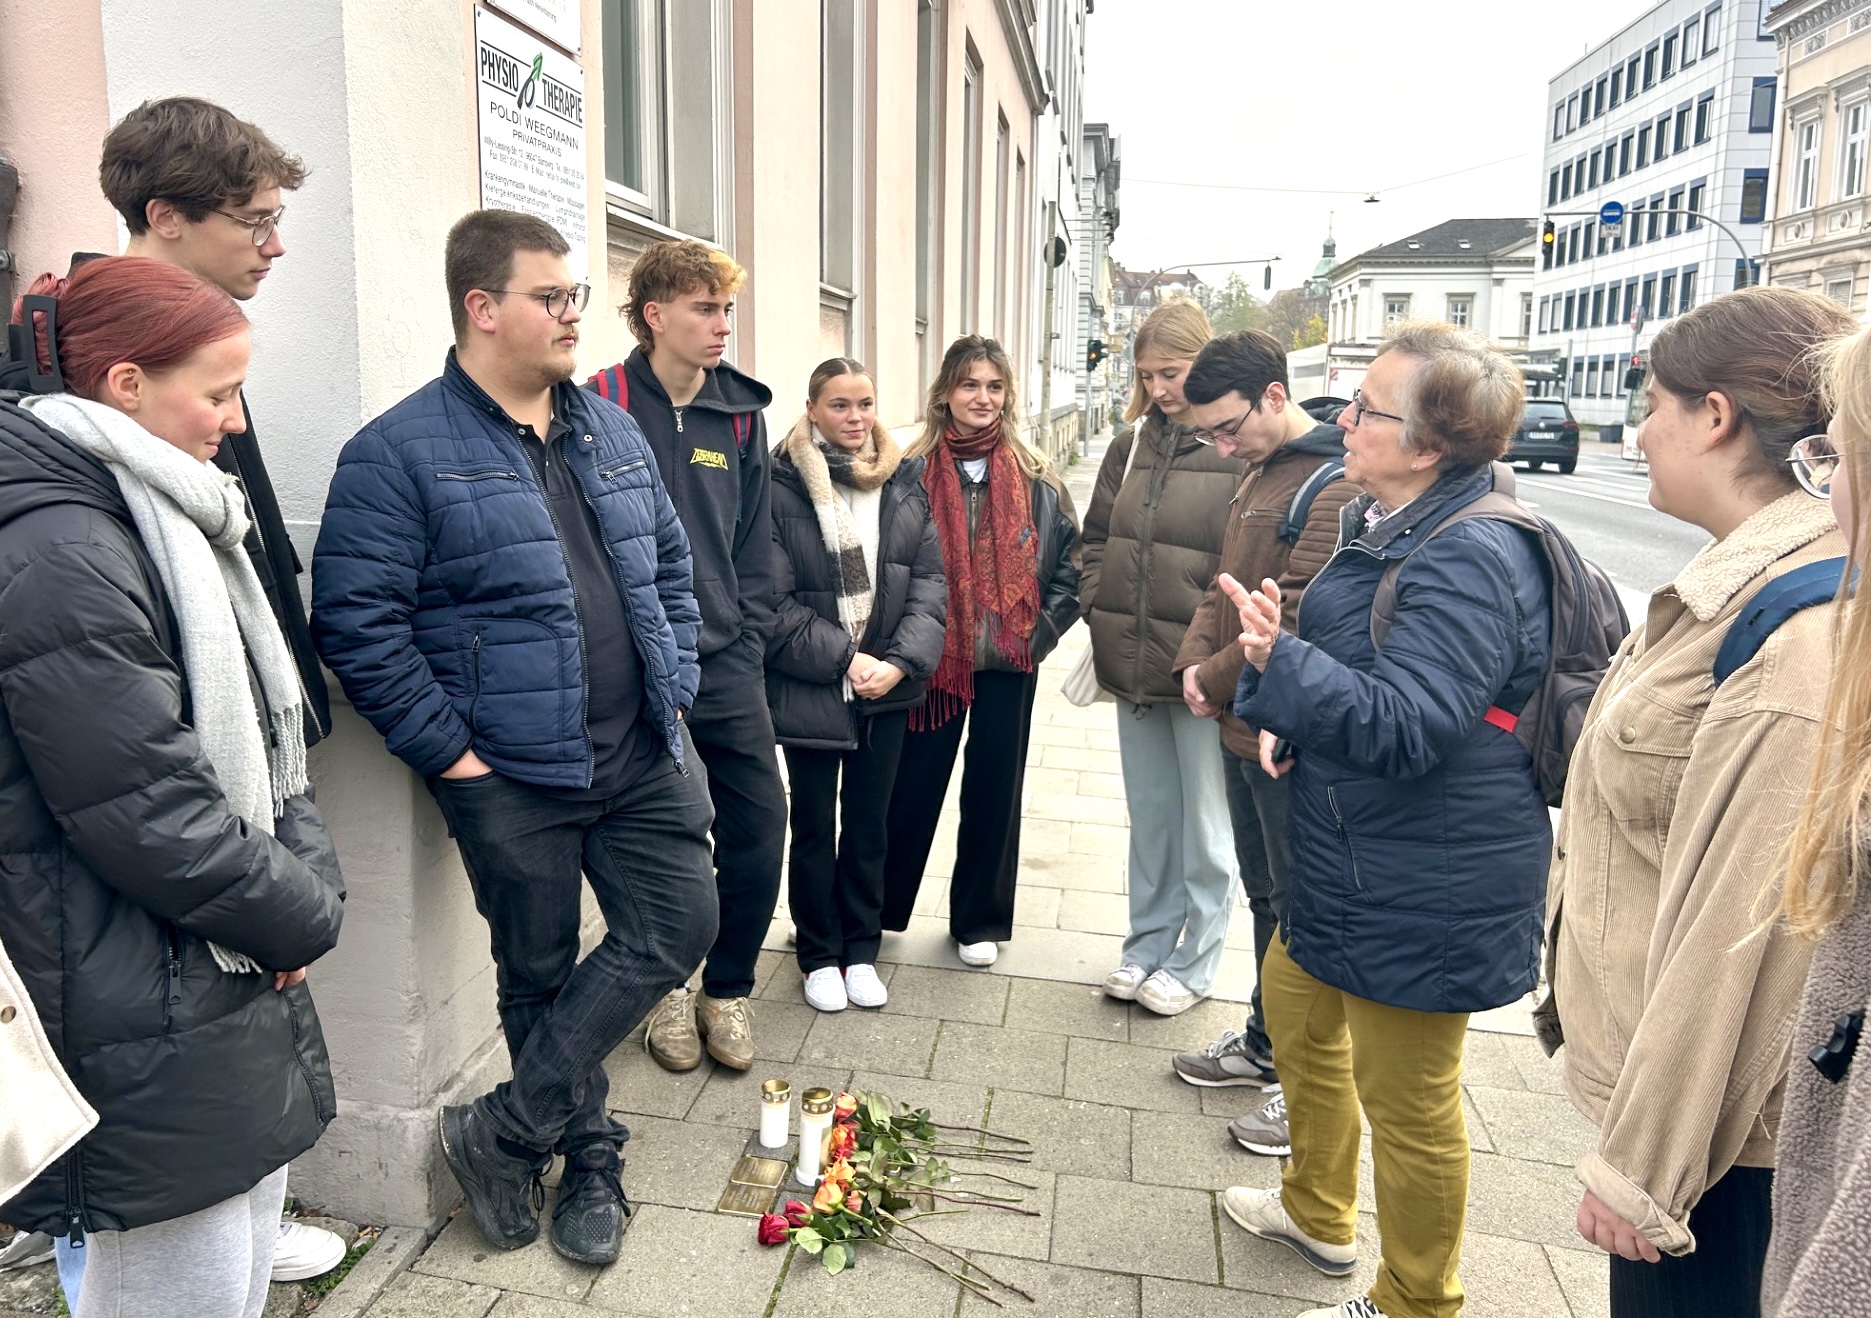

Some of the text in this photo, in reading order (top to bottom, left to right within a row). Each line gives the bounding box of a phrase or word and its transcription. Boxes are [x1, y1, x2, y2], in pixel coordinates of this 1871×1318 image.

[480, 46, 583, 123] PHYSIO THERAPIE
[490, 101, 579, 150] POLDI WEEGMANN
[512, 129, 562, 157] PRIVATPRAXIS
[484, 169, 526, 191] Krankengymnastik
